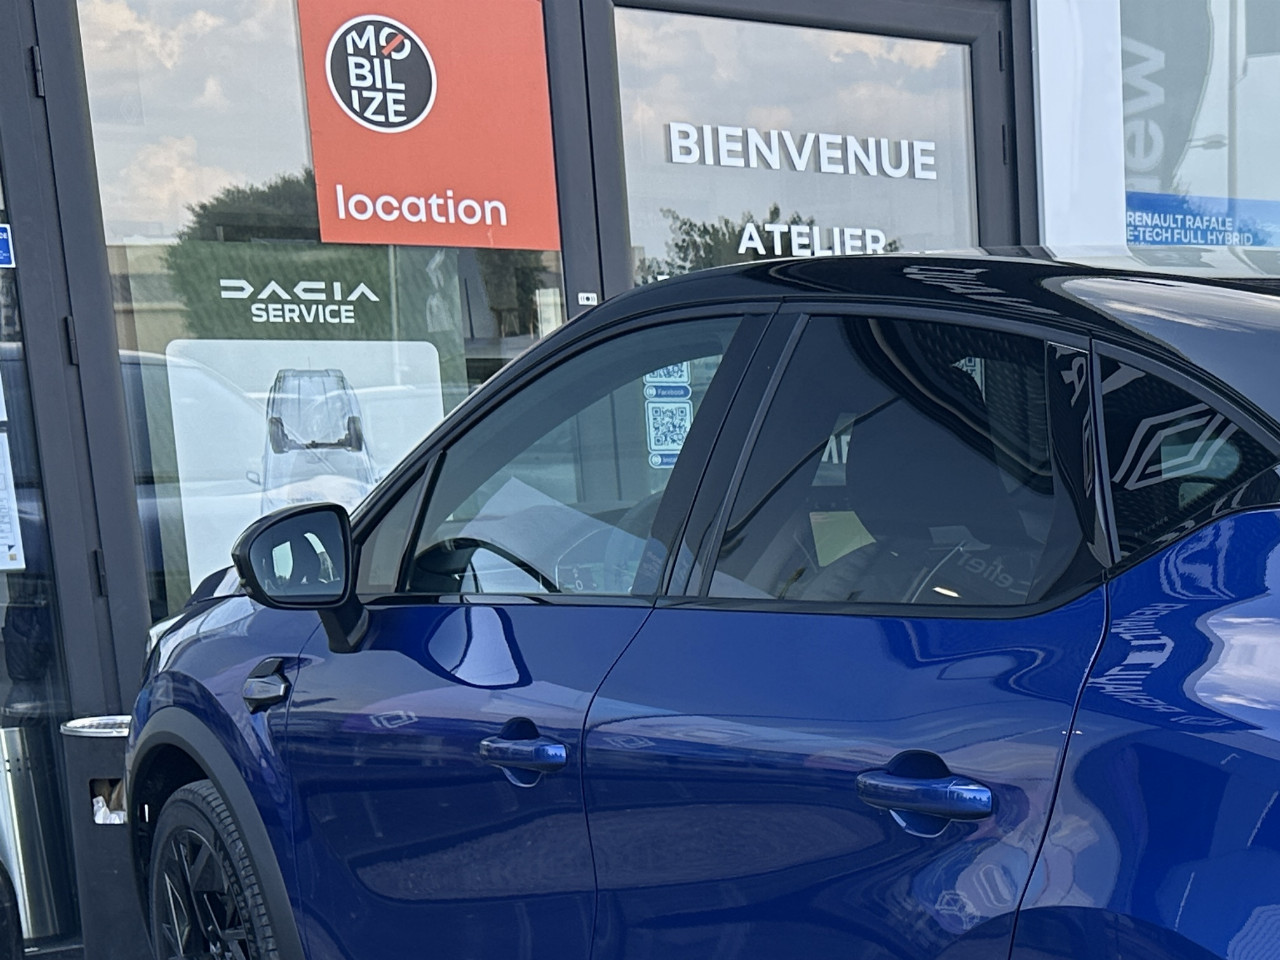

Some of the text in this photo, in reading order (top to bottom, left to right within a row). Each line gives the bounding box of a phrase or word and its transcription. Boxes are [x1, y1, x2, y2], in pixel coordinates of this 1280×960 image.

[347, 55, 406, 91] BIL
[351, 89, 408, 123] IZE
[668, 121, 938, 180] BIENVENUE
[335, 184, 508, 227] location
[1127, 211, 1233, 231] RENAULT RAFALE
[737, 222, 887, 256] ATELIER
[1126, 226, 1254, 246] E-TECH FULL HYBRID
[219, 278, 380, 302] DACIA
[250, 303, 355, 324] SERVICE
